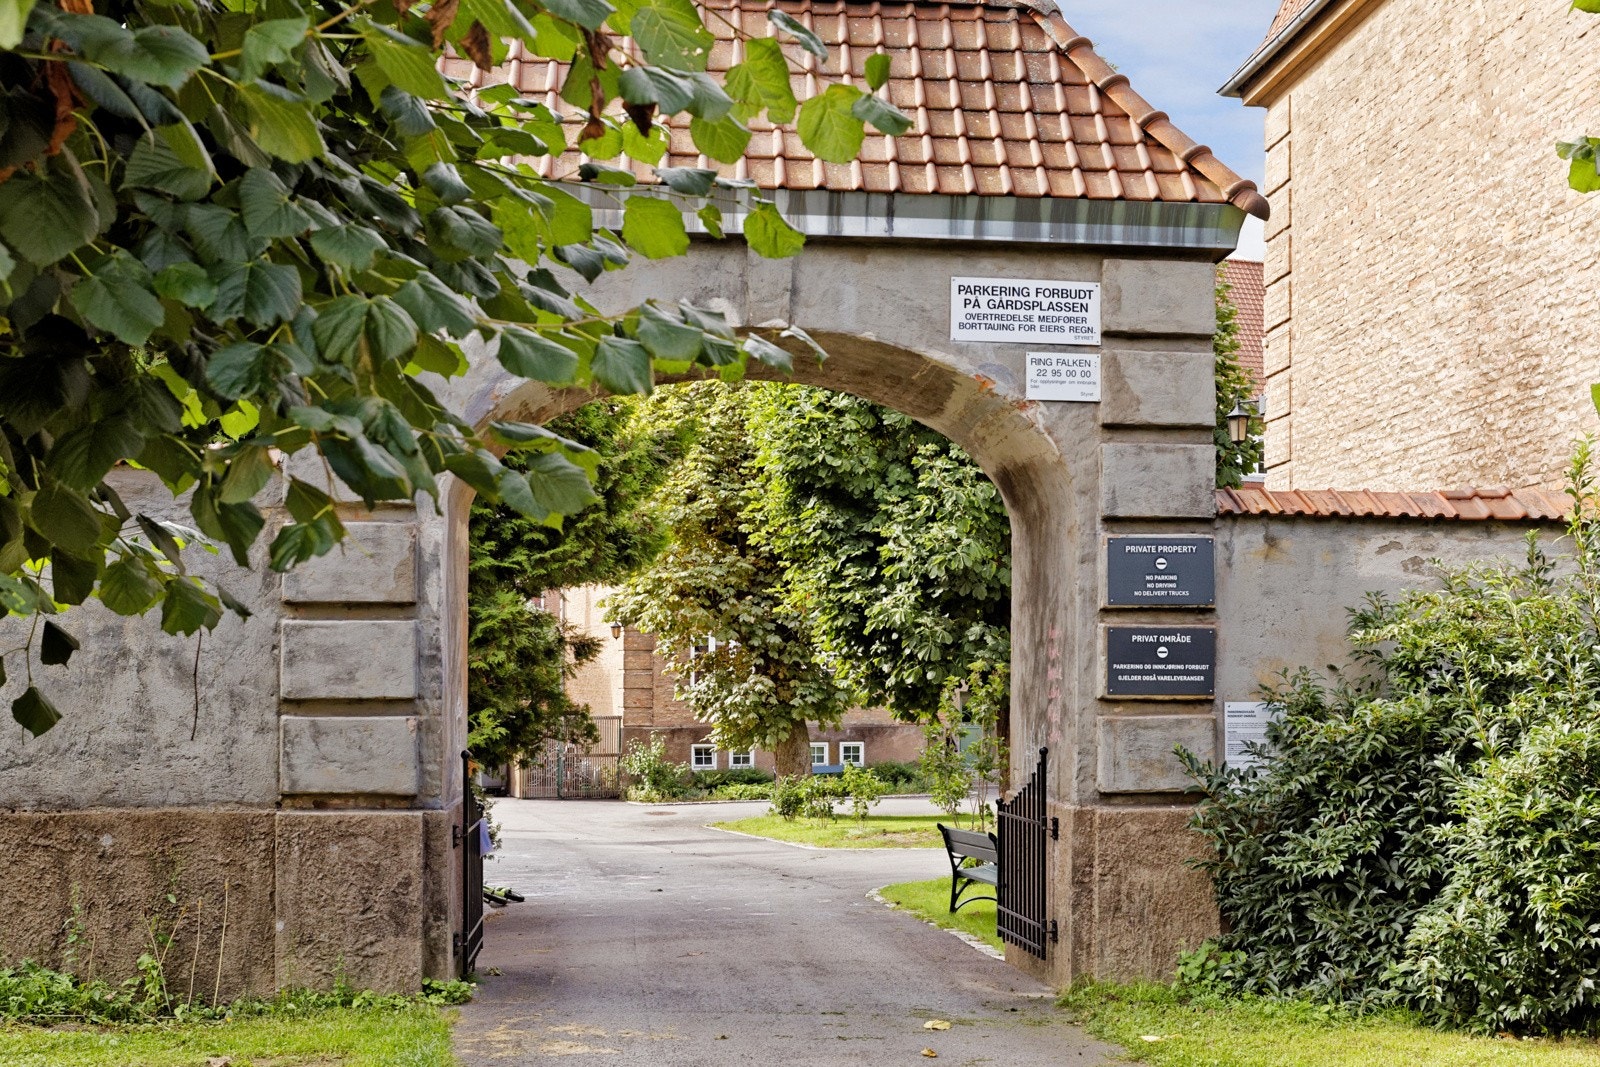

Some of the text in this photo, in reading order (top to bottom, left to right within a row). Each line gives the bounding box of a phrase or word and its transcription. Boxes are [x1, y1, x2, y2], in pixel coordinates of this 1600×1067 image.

[958, 285, 1094, 300] PARKERING FORBUDT
[964, 296, 1088, 312] PÅ GÅRDSPLASSEN
[965, 313, 1087, 324] OVERTREDELSE MEDFØRER
[959, 322, 1015, 331] BORTTAUING
[1030, 358, 1052, 366] RING
[1159, 633, 1191, 643] OMRÅDE
